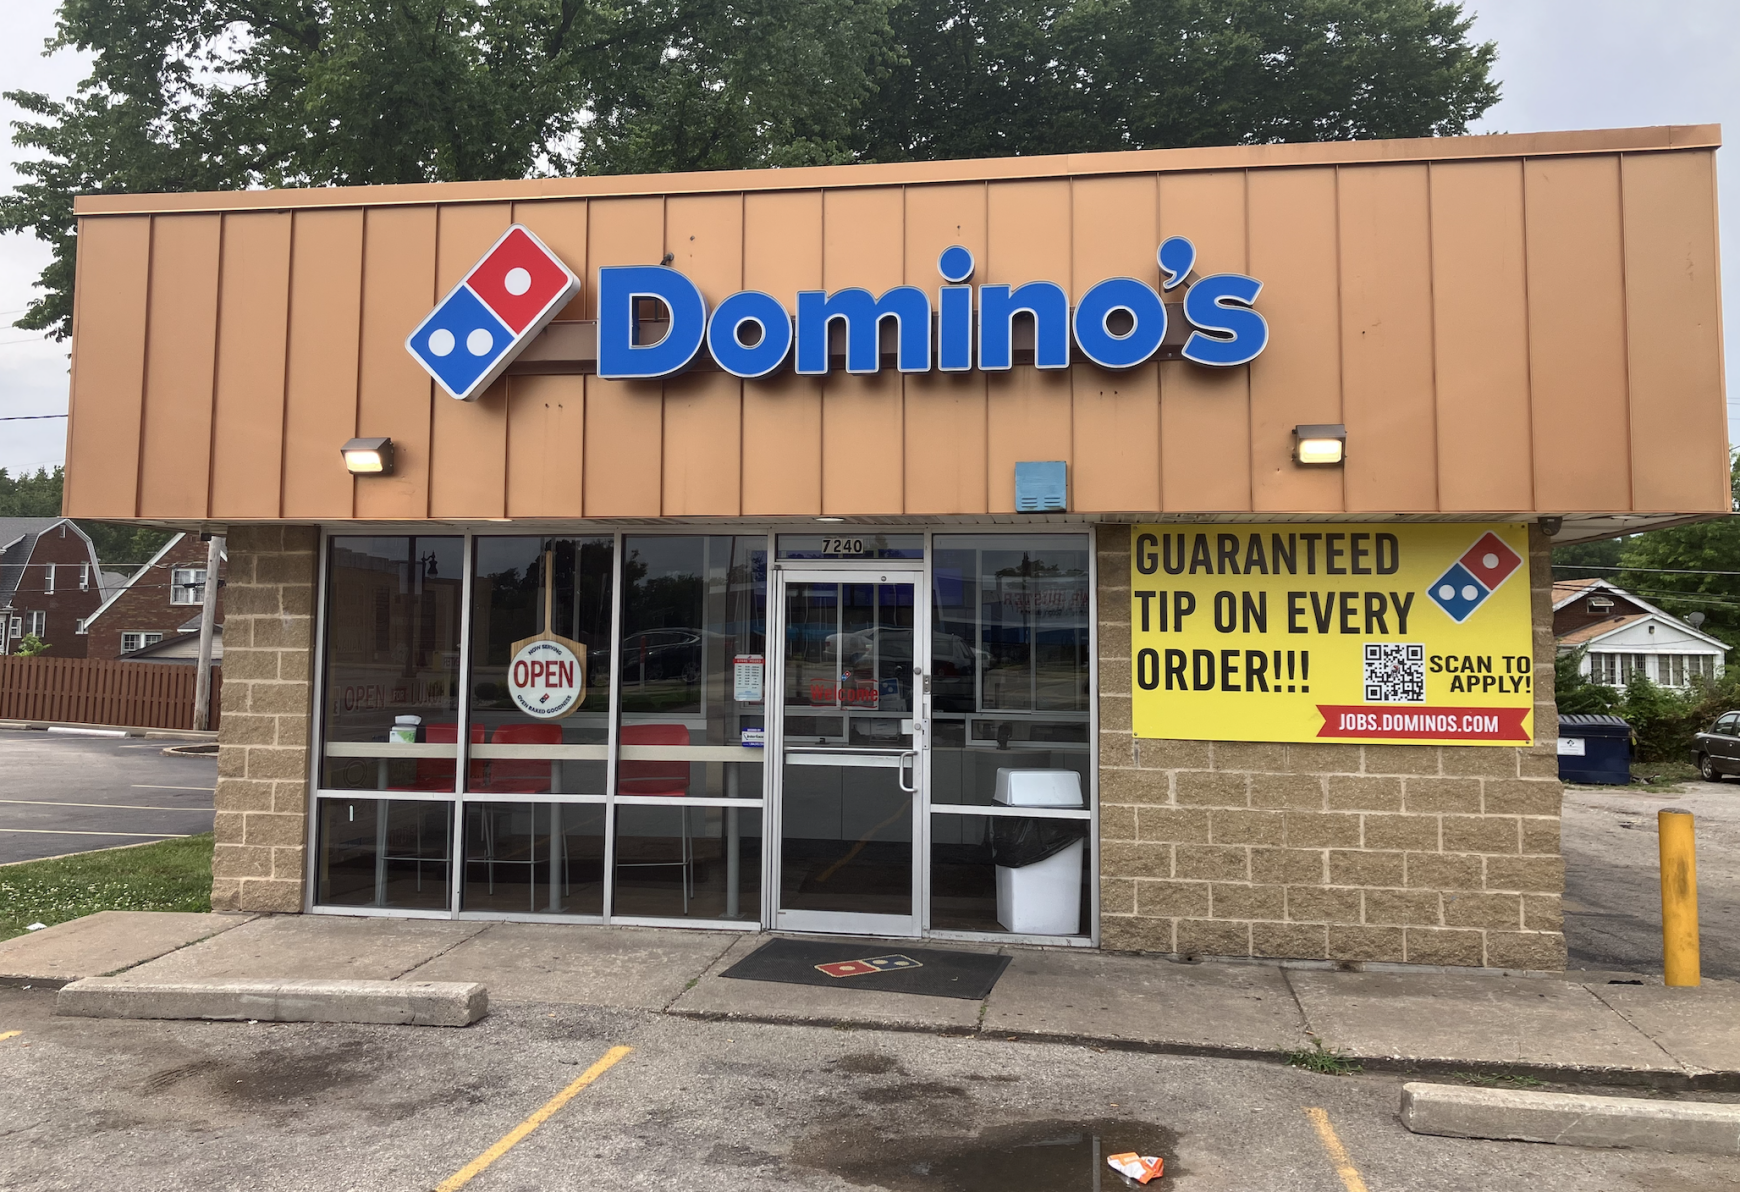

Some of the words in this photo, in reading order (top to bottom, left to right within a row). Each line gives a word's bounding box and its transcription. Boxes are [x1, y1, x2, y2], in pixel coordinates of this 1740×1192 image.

[596, 235, 1269, 380] Domino's
[823, 540, 862, 553] 7240
[1136, 533, 1399, 575] GUARANTEED
[1134, 590, 1196, 632] TIP
[1214, 590, 1267, 633] ON
[1288, 591, 1415, 634] EVERY
[528, 645, 541, 655] NOW
[541, 644, 562, 655] SERVING
[1137, 647, 1310, 693] ORDER!!!
[1429, 655, 1492, 673] SCAN
[1502, 656, 1531, 673] TO
[513, 660, 574, 689] OPEN
[1450, 675, 1531, 693] APPLY!
[344, 684, 386, 712] OPEN
[810, 684, 878, 702] Welcome
[517, 694, 529, 708] OVEN
[528, 705, 545, 714] BAKED
[546, 695, 572, 714] GOODNESS
[1339, 713, 1499, 733] JOBS.DOMINOS.COM
